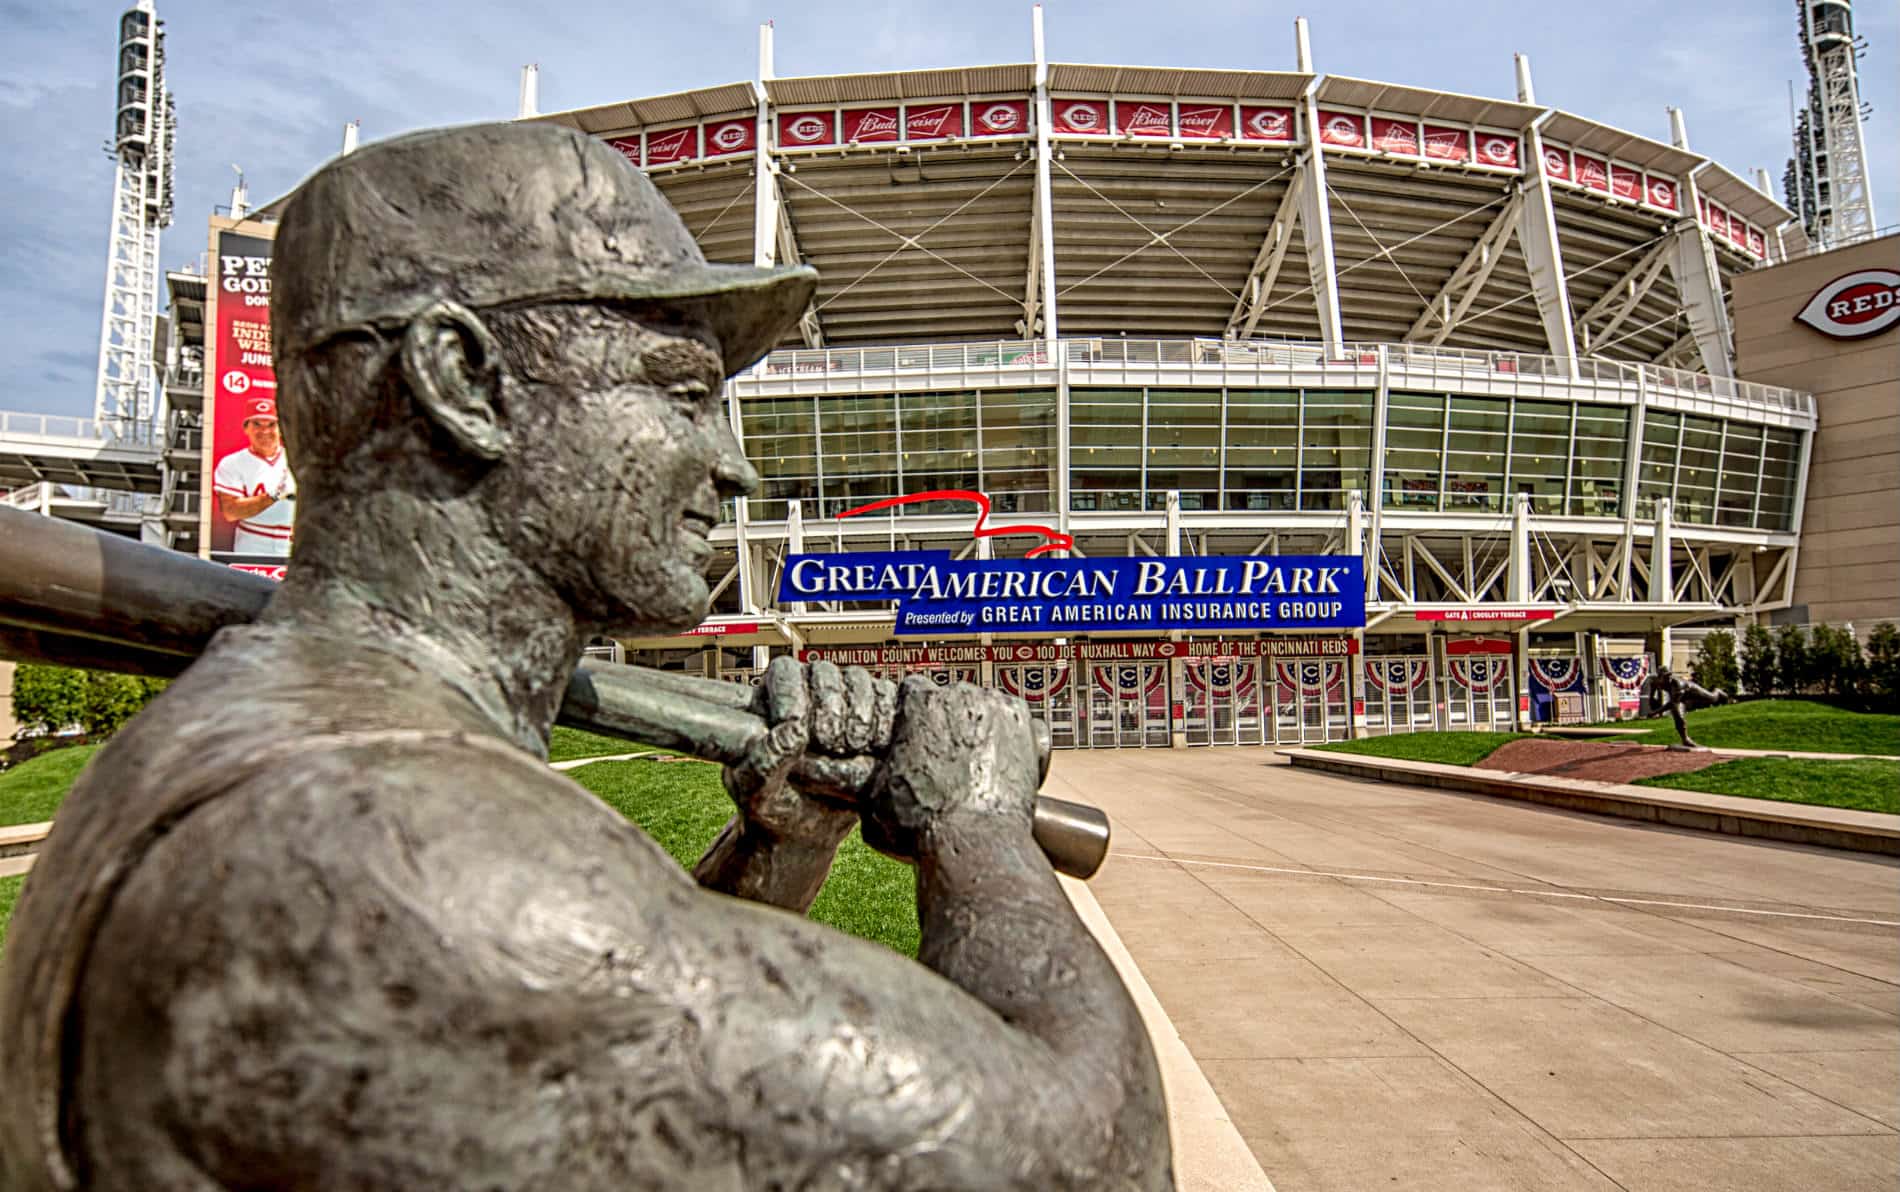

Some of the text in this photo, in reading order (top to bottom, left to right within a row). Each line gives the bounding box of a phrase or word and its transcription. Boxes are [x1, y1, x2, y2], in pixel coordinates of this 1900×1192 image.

[860, 116, 942, 131] Budeiser
[1133, 111, 1214, 126] Budeiser
[221, 255, 272, 276] PE
[245, 295, 271, 306] DON
[238, 338, 272, 352] WEE
[228, 374, 245, 389] 14
[791, 559, 1341, 599] GREAT AMERICAN BALL PARK
[905, 601, 1342, 626] Presented by GREAT AMERICAN INSURANCE GROUP
[823, 640, 1348, 665] HAMILTON COUNTY WELCOMES YOU 100 JOE NUXHALL WAY HOME OF THE CINCINNATI REDS
